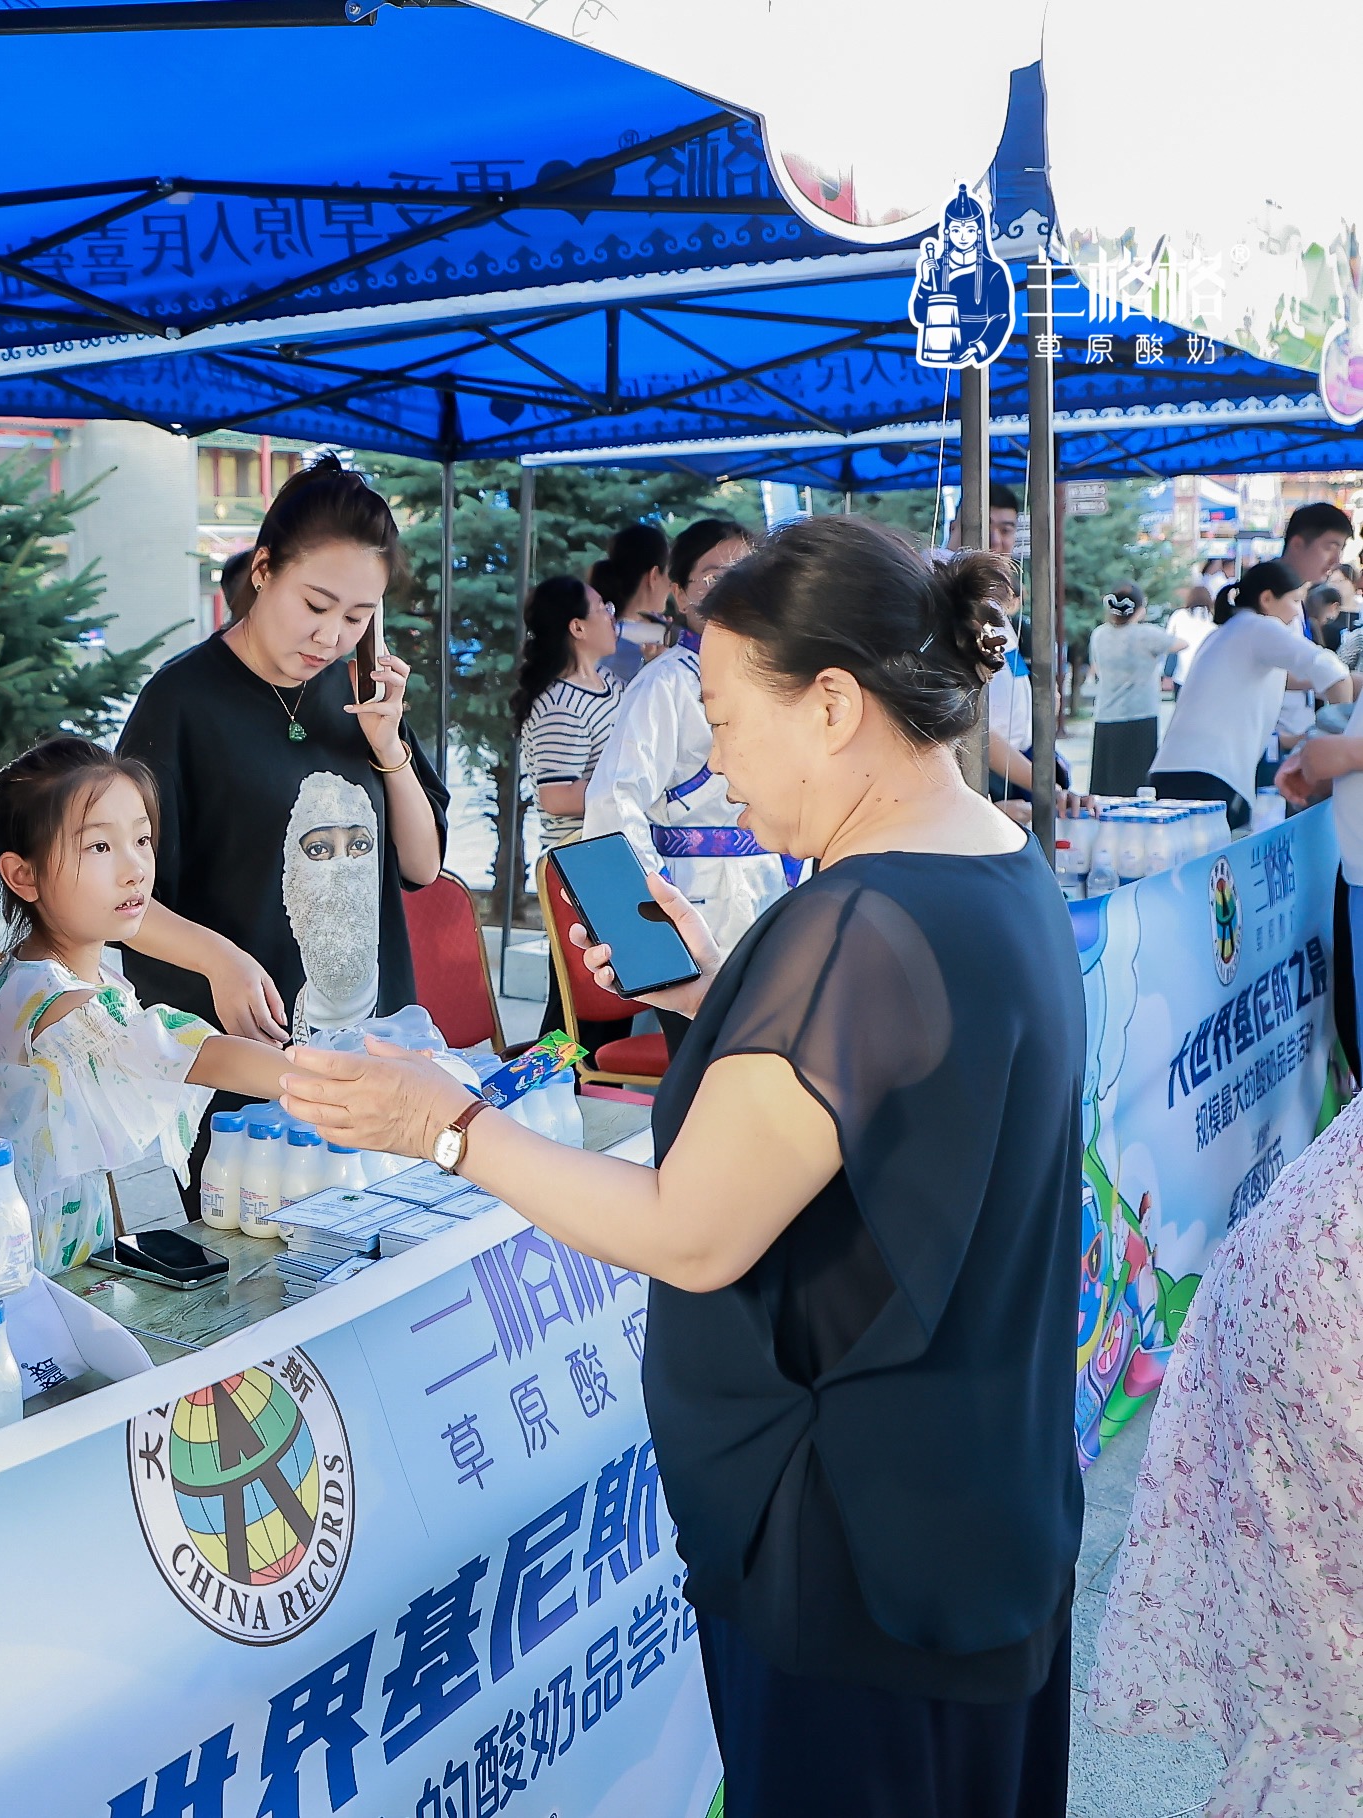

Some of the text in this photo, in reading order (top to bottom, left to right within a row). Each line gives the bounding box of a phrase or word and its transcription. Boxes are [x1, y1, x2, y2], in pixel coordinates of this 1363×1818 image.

[1168, 936, 1327, 1109] 大世界基尼斯之最
[172, 1454, 345, 1630] CHINA RECORDS
